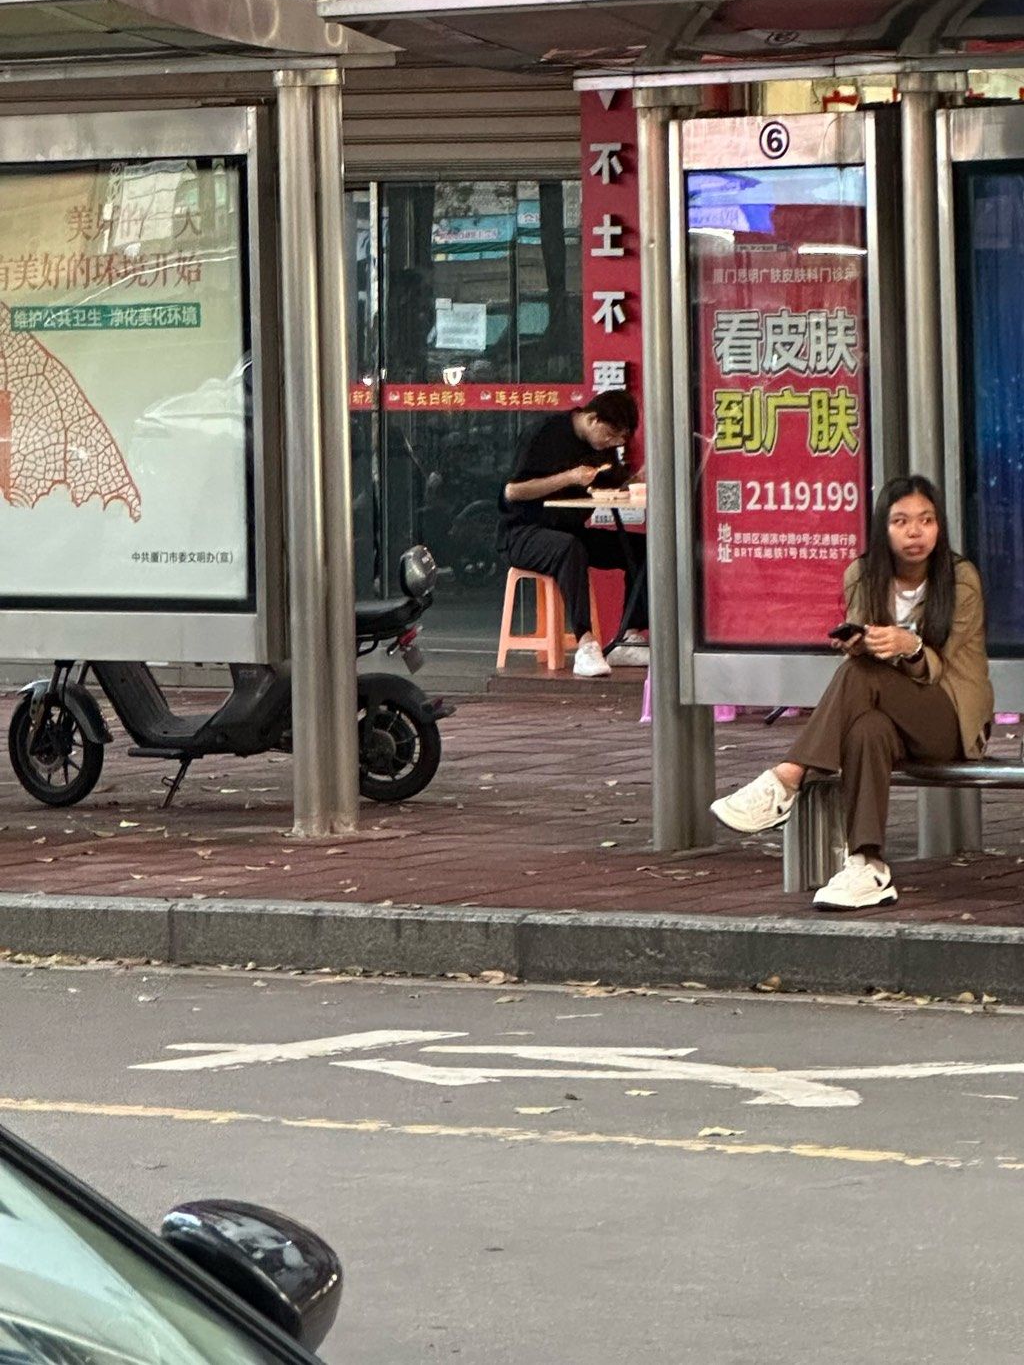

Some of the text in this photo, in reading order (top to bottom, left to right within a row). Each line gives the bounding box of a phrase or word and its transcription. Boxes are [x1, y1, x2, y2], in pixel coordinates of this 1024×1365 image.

[14, 305, 198, 329] 维护公共卫生 净化美化环境
[590, 141, 628, 466] 不土不要
[713, 308, 857, 377] 看皮肤
[714, 385, 858, 456] 到广肤
[746, 480, 858, 512] 2119199
[717, 522, 733, 563] 地址
